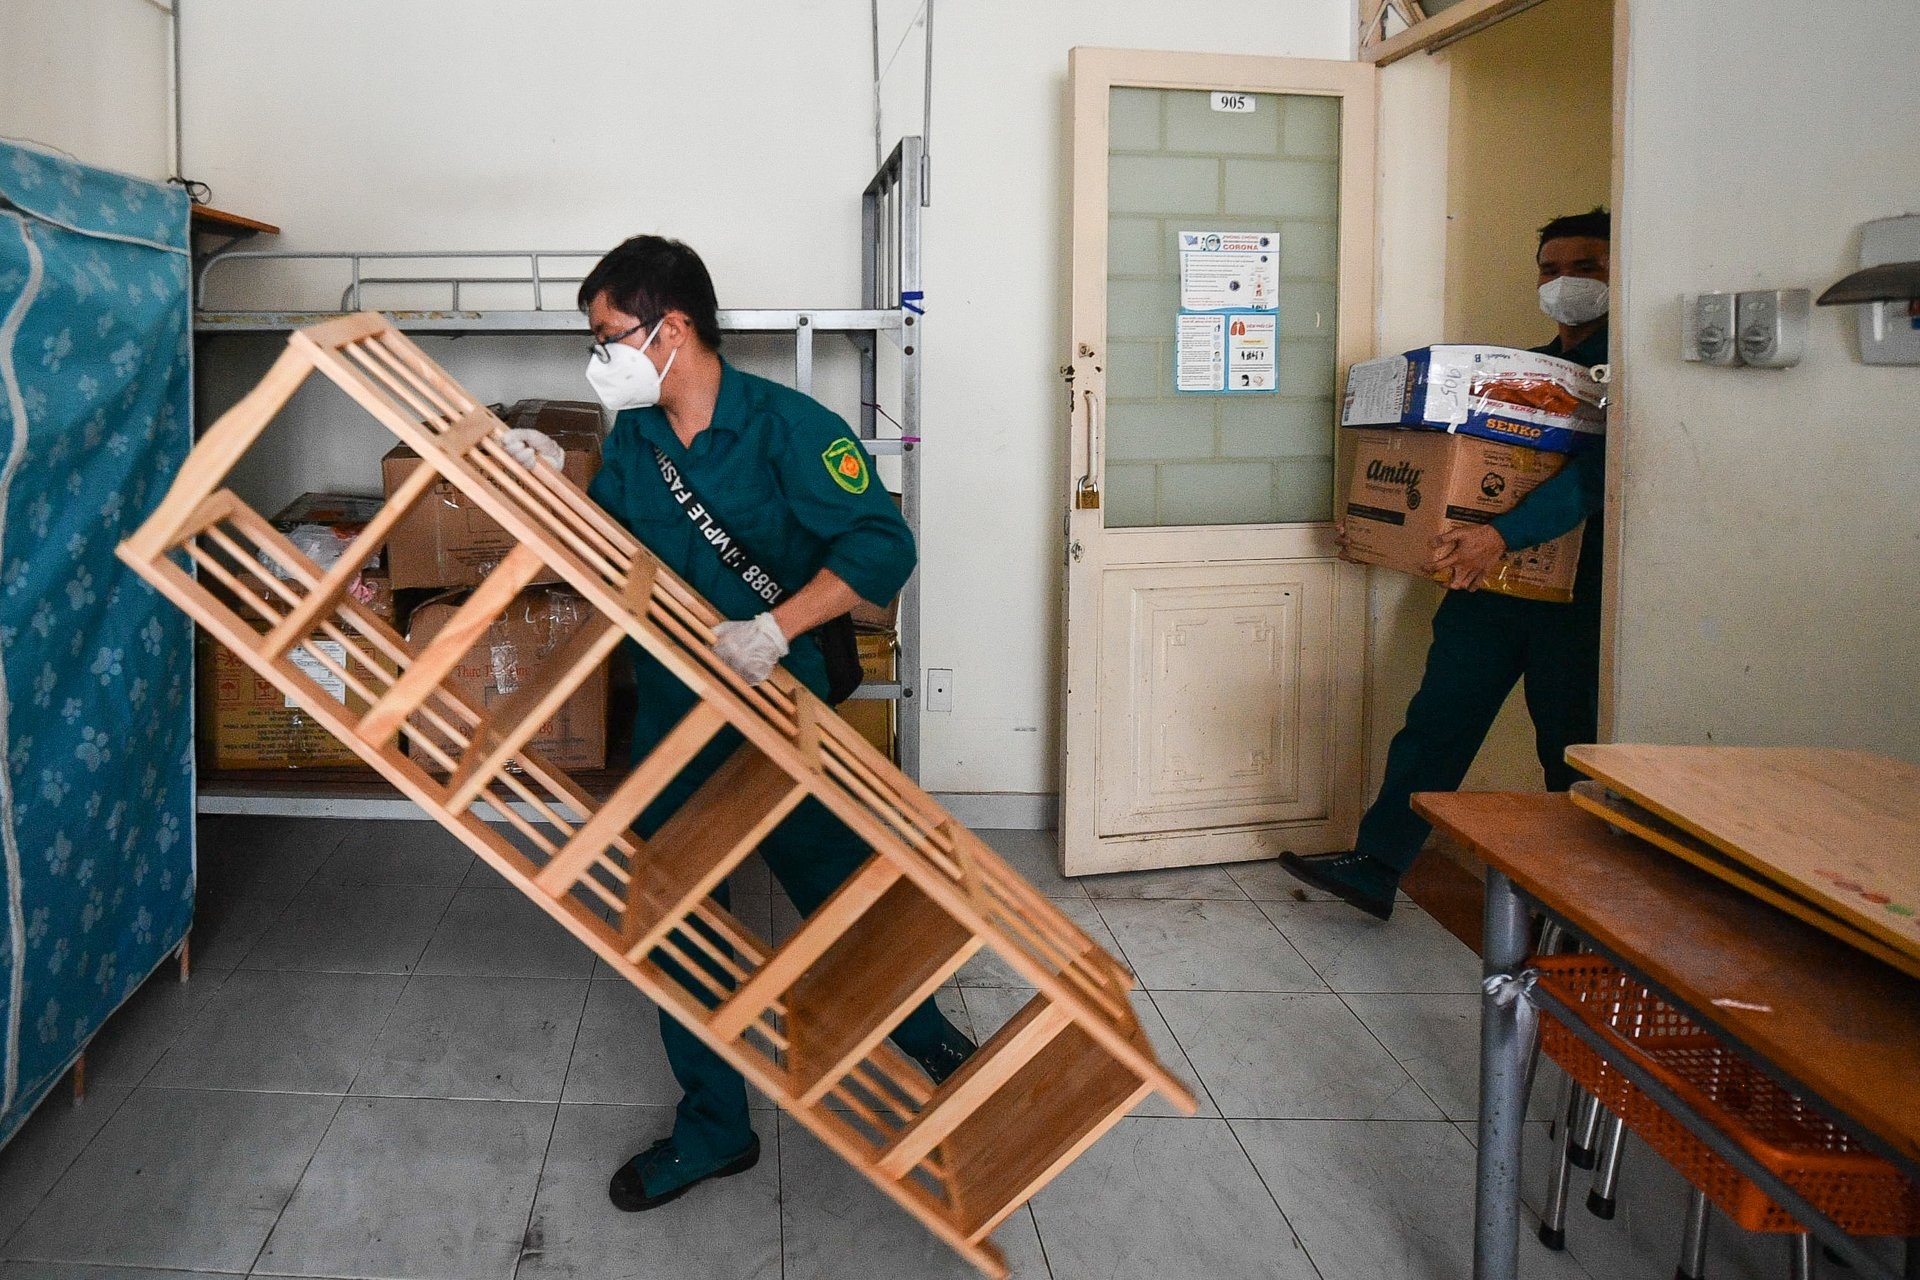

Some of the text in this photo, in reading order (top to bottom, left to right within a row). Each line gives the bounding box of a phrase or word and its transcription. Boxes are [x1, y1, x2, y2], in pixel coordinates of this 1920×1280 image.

[1221, 95, 1246, 110] 905
[1222, 243, 1259, 251] CORONA
[1441, 367, 1463, 407] 905
[1485, 418, 1542, 438] SENKO
[742, 564, 783, 605] 1988
